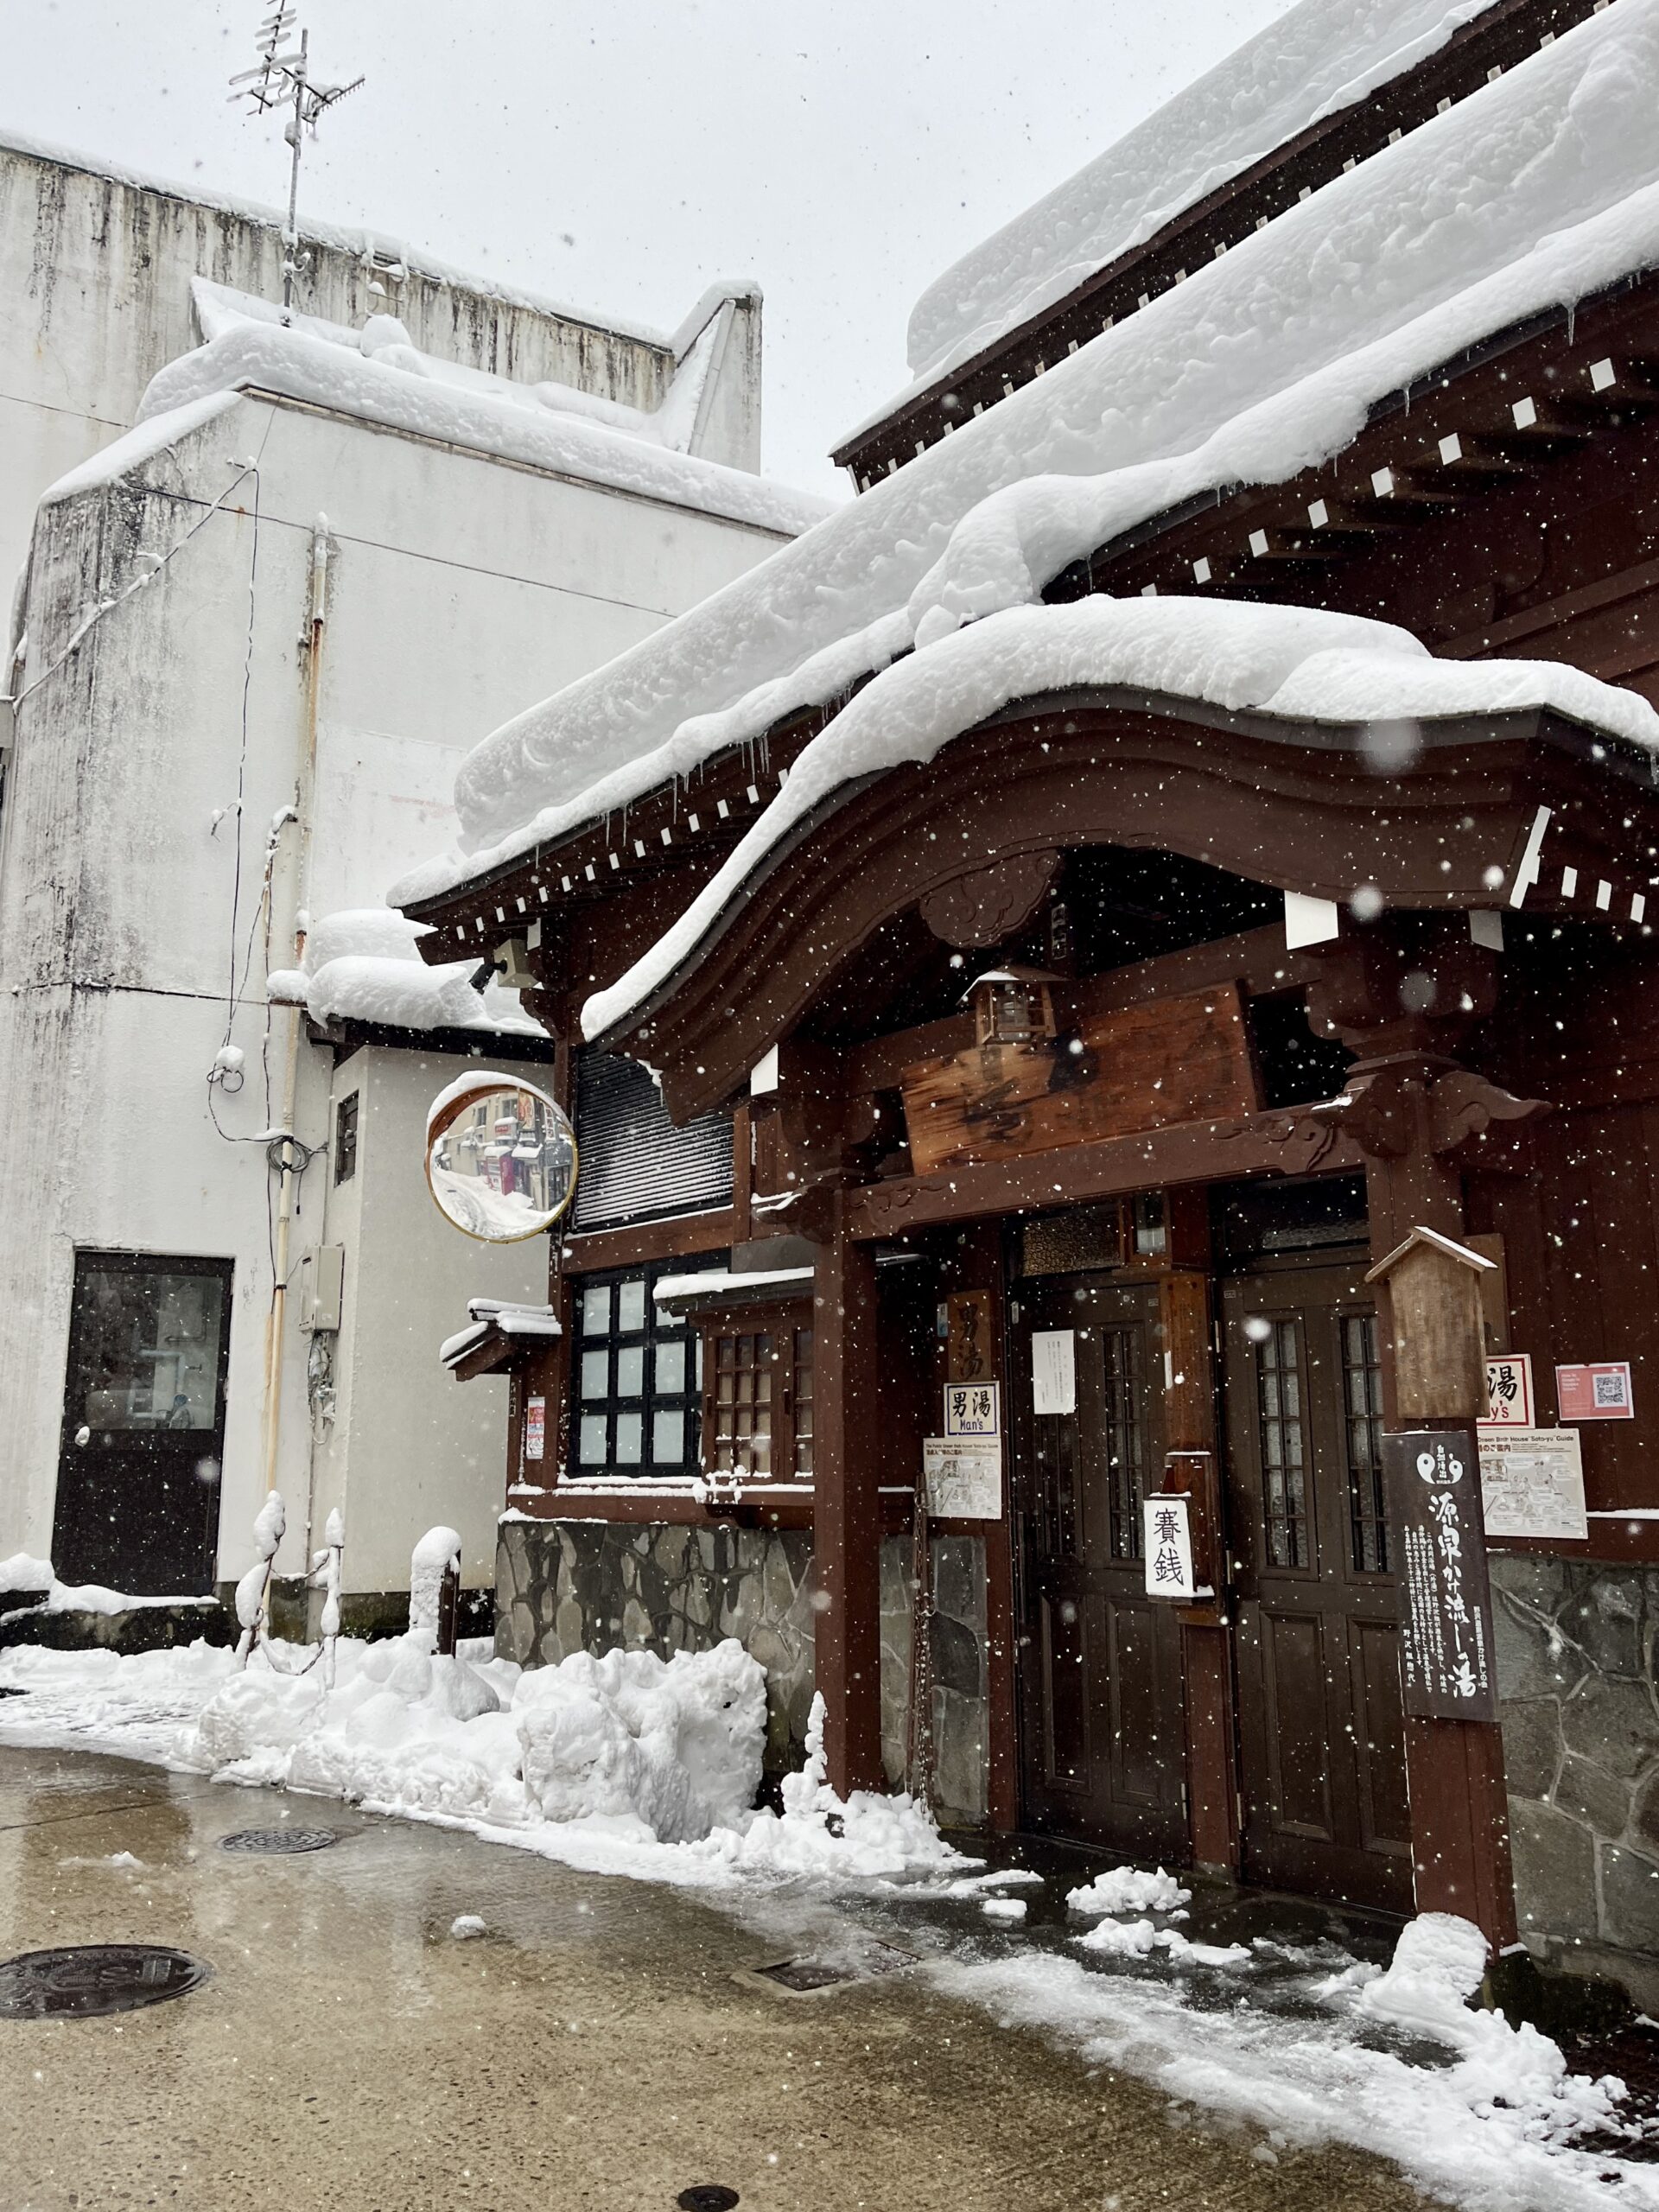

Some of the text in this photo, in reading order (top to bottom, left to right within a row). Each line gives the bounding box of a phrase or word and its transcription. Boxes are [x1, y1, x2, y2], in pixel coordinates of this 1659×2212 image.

[957, 1303, 983, 1380] 男湯
[953, 1390, 990, 1418] 男湯
[960, 1418, 983, 1431] Man's
[1154, 1507, 1185, 1586] 賽銭
[1428, 1491, 1477, 1698] 源泉かけ流しの湯
